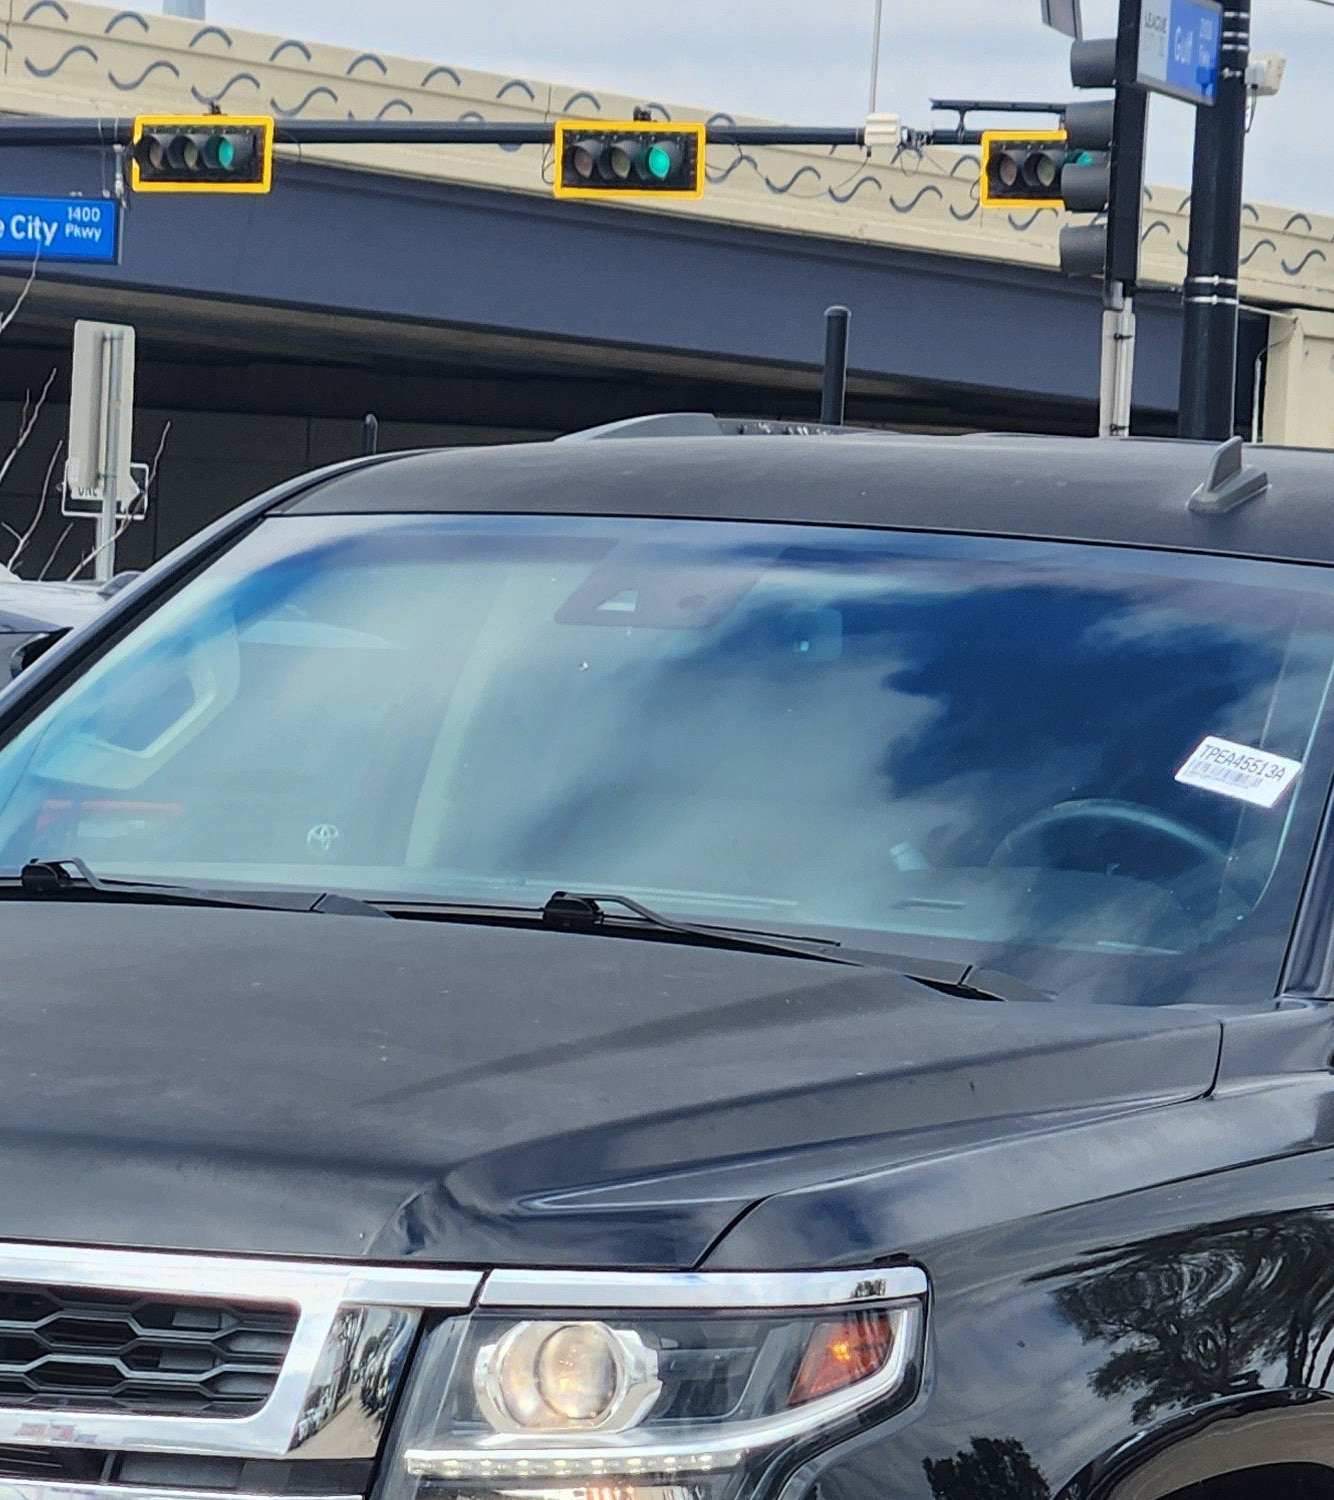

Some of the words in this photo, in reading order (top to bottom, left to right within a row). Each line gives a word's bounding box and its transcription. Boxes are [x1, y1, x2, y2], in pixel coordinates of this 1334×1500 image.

[67, 206, 101, 222] 1400
[10, 214, 58, 246] City
[64, 223, 102, 242] Pkwy
[1199, 744, 1287, 781] TPEA45513A
